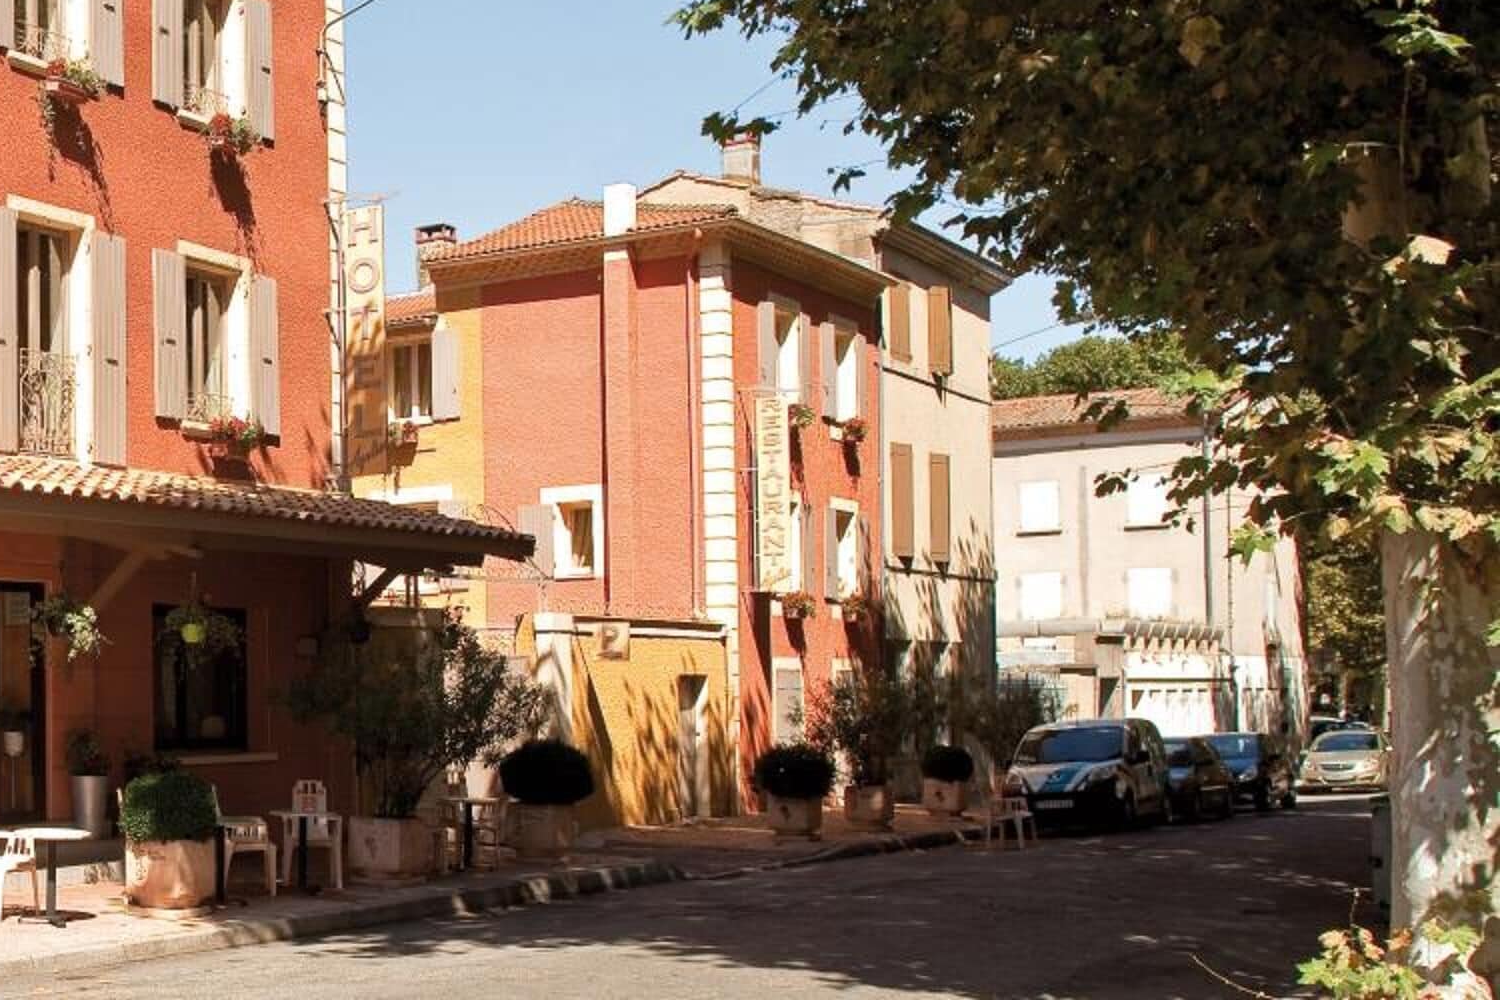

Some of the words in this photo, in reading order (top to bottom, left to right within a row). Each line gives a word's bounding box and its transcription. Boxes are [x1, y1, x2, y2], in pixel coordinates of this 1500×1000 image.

[347, 208, 385, 438] HOTEL
[761, 400, 785, 567] RESTAURANT
[601, 624, 620, 651] P
